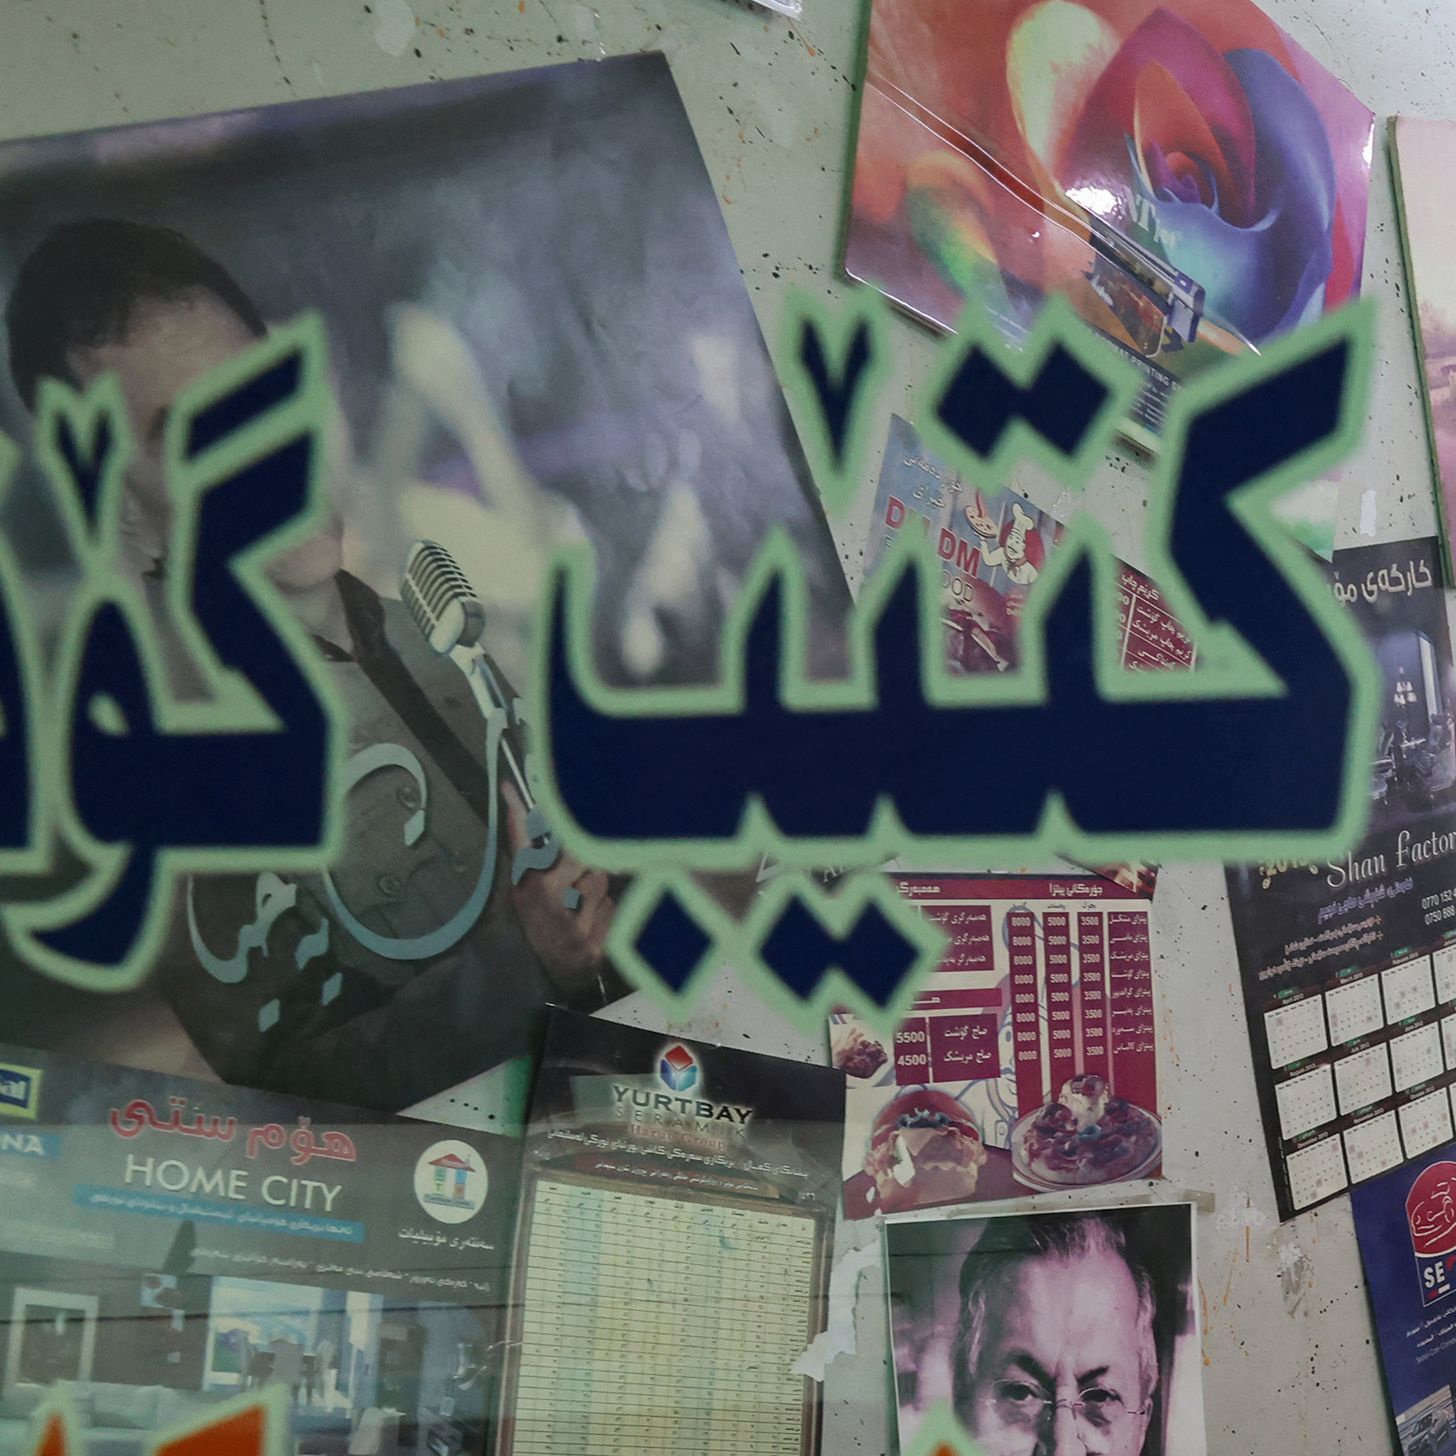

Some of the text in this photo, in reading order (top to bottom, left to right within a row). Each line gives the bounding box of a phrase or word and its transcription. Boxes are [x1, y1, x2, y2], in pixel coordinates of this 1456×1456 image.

[0, 312, 346, 992] گۆ
[1326, 850, 1386, 890] Shan
[1081, 916, 1099, 926] 3500
[1082, 935, 1100, 945] 3500
[1082, 954, 1100, 964] 3500
[1083, 972, 1101, 982] 3500
[1083, 990, 1101, 1000] 3500
[1084, 1009, 1102, 1019] 3500
[896, 1031, 925, 1043] 5500
[1085, 1027, 1103, 1037] 3500
[1085, 1046, 1103, 1056] 3500
[897, 1054, 927, 1067] 4500
[613, 1085, 752, 1125] YURTBAY
[247, 1116, 357, 1165] هۆم
[124, 1153, 249, 1201] HOME
[260, 1175, 344, 1213] CITY
